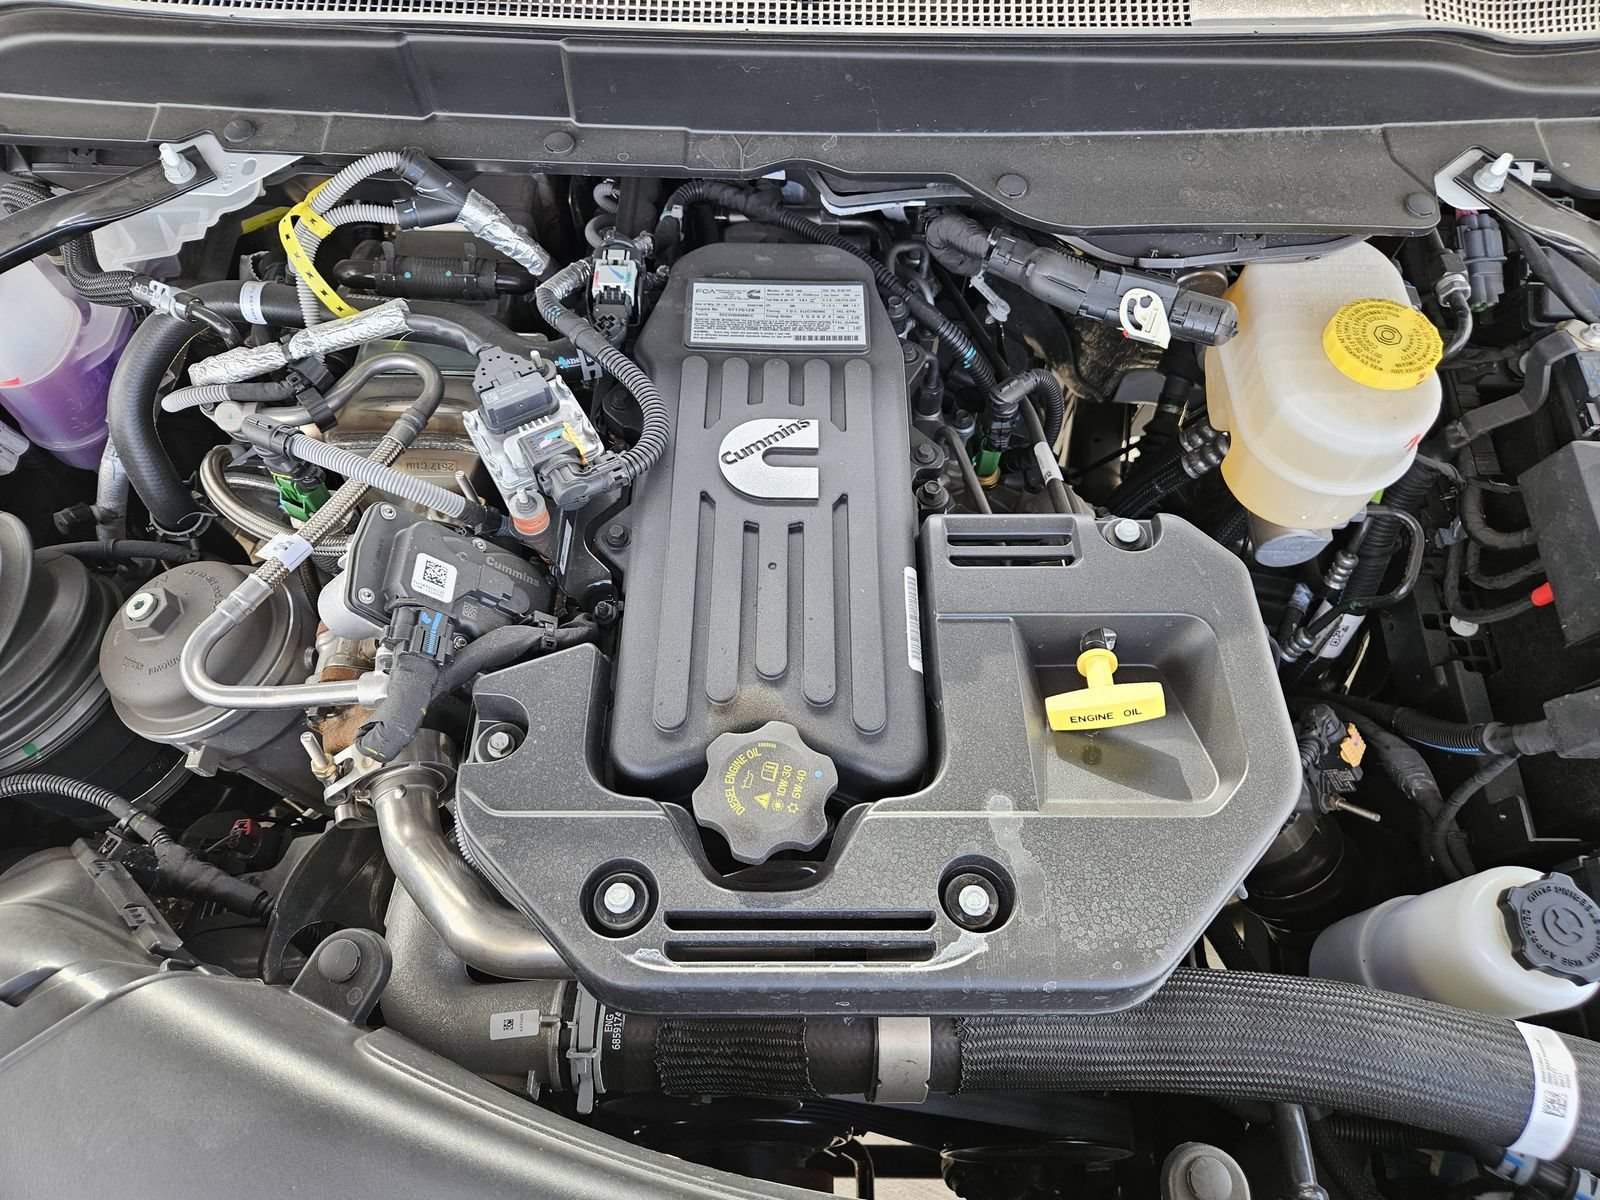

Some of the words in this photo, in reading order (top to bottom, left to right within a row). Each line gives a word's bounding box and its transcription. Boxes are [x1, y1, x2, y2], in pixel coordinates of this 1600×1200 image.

[720, 419, 810, 465] Cummins
[430, 462, 455, 471] 2517
[486, 556, 540, 587] Cummins
[1070, 712, 1113, 723] ENGINE
[1124, 708, 1142, 717] OIL
[746, 747, 762, 759] OIL
[724, 754, 748, 784] ENGINE
[777, 764, 793, 797] 10W-30
[792, 770, 807, 799] 5W-40
[725, 786, 746, 816] DIESEL
[1522, 909, 1556, 960] APPROVED
[1562, 956, 1584, 968] USE
[604, 1014, 615, 1032] ENG
